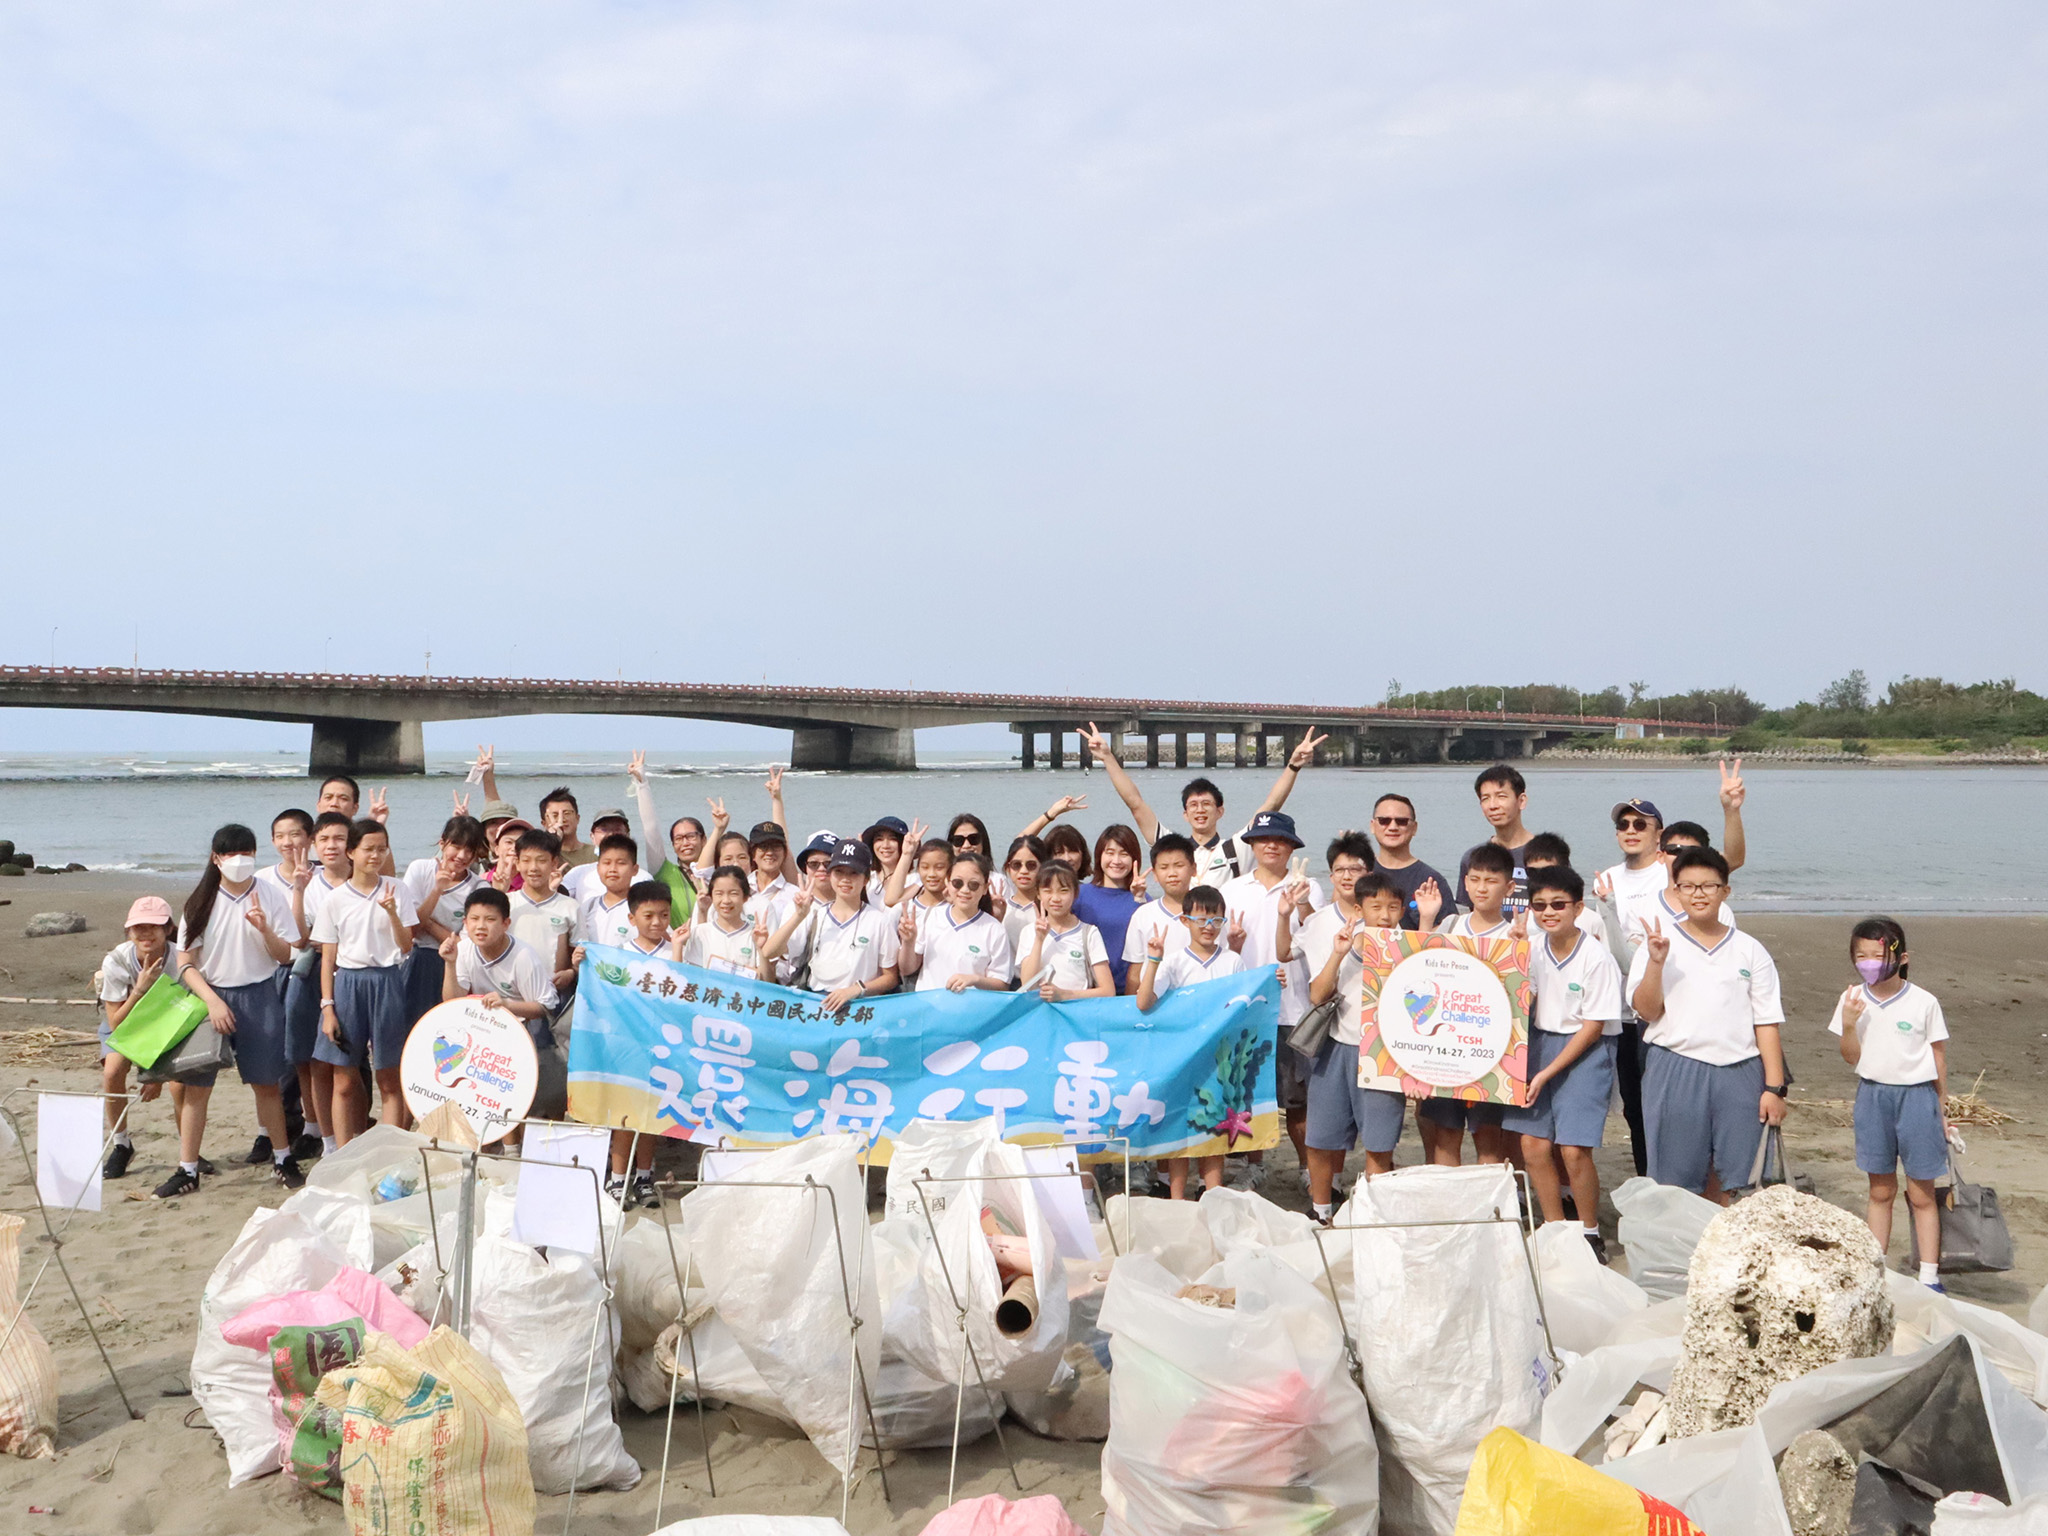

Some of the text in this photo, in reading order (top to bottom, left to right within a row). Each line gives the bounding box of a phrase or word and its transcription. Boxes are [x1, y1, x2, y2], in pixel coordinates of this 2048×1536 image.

[841, 844, 856, 856] NY
[1424, 958, 1439, 968] Kids
[1451, 961, 1469, 971] Peace
[1451, 990, 1482, 1004] Great
[1442, 999, 1491, 1015] Kindness
[464, 1007, 478, 1019] Kids
[489, 1016, 508, 1030] Peace
[1441, 1011, 1491, 1028] Challenge
[1456, 1034, 1483, 1046] TCSH
[481, 1047, 513, 1067] Great
[1391, 1039, 1434, 1054] January
[1470, 1048, 1495, 1059] 2023
[469, 1054, 518, 1081] Kindness
[465, 1065, 515, 1092] Challenge
[475, 1093, 501, 1110] TCSH
